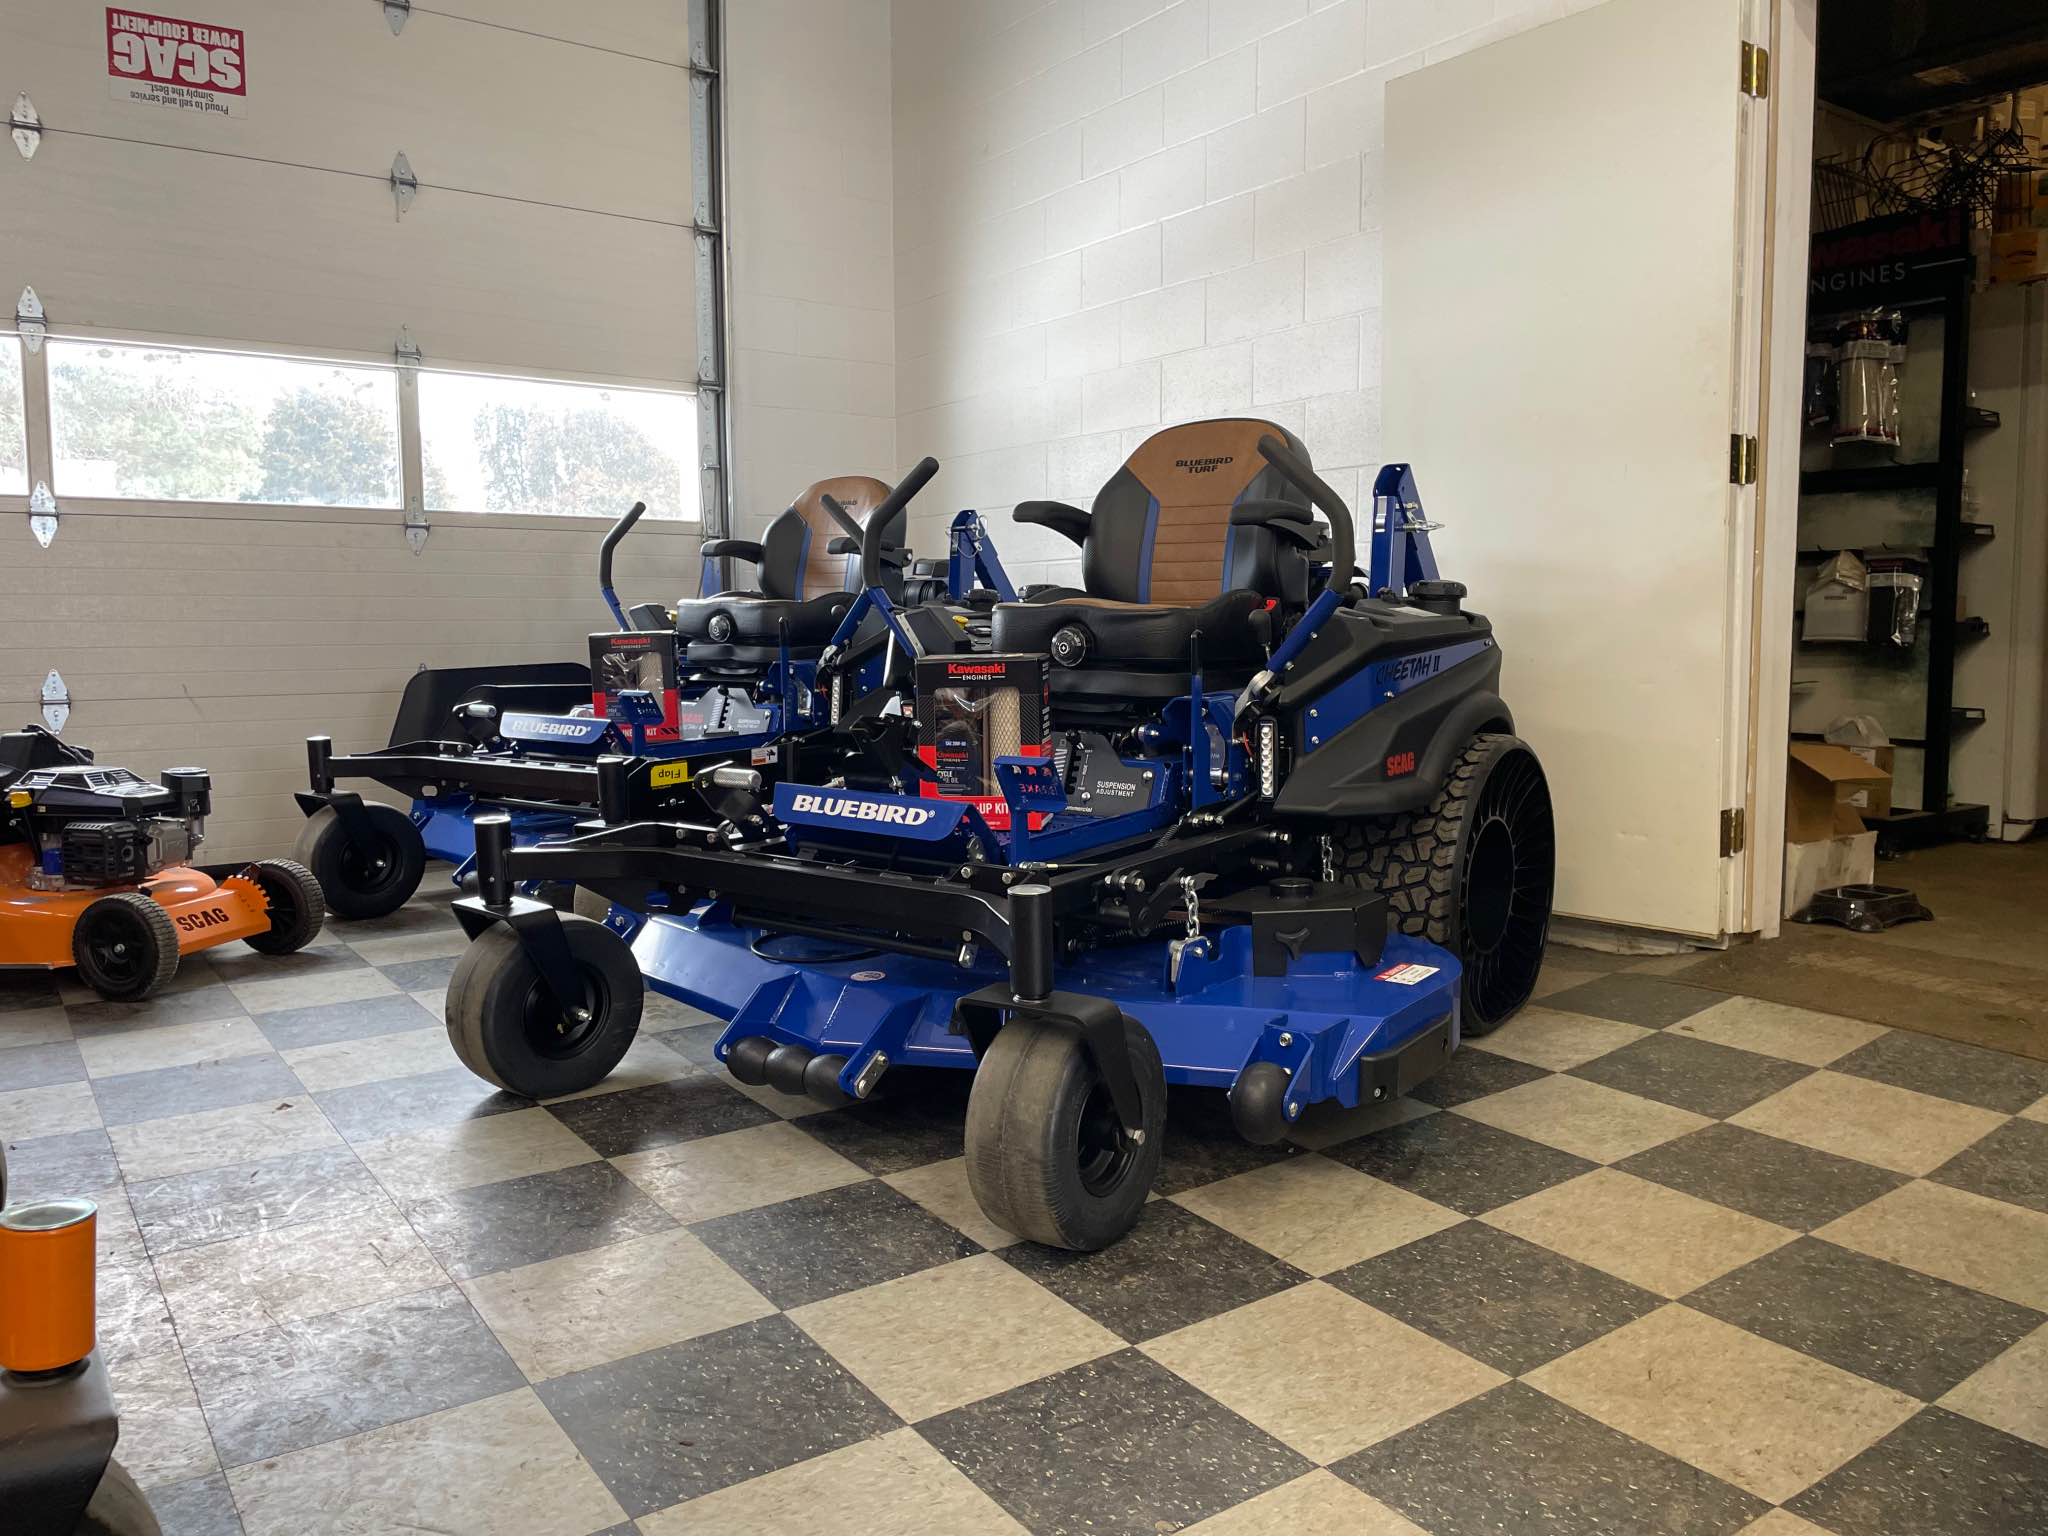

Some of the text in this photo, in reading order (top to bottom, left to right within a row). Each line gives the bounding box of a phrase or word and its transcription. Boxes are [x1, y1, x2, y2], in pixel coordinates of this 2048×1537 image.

[112, 13, 240, 49] POWER EQUIPMENT
[112, 31, 241, 89] SCAG
[171, 86, 184, 98] the
[186, 88, 214, 102] Simply
[130, 91, 229, 115] Proud to sell and service
[1811, 261, 1906, 295] NGINES
[1175, 457, 1233, 467] BLUEBIRD
[1189, 464, 1219, 474] TURF
[947, 663, 1007, 674] Kawasaki
[646, 728, 657, 736] KIT
[1387, 752, 1415, 777] SCAG
[658, 768, 681, 779] Flap
[1096, 780, 1137, 791] SUSPENSION
[1095, 788, 1135, 797] ADJUSTMENT
[995, 803, 1009, 815] KIT
[176, 907, 230, 931] SCAG
